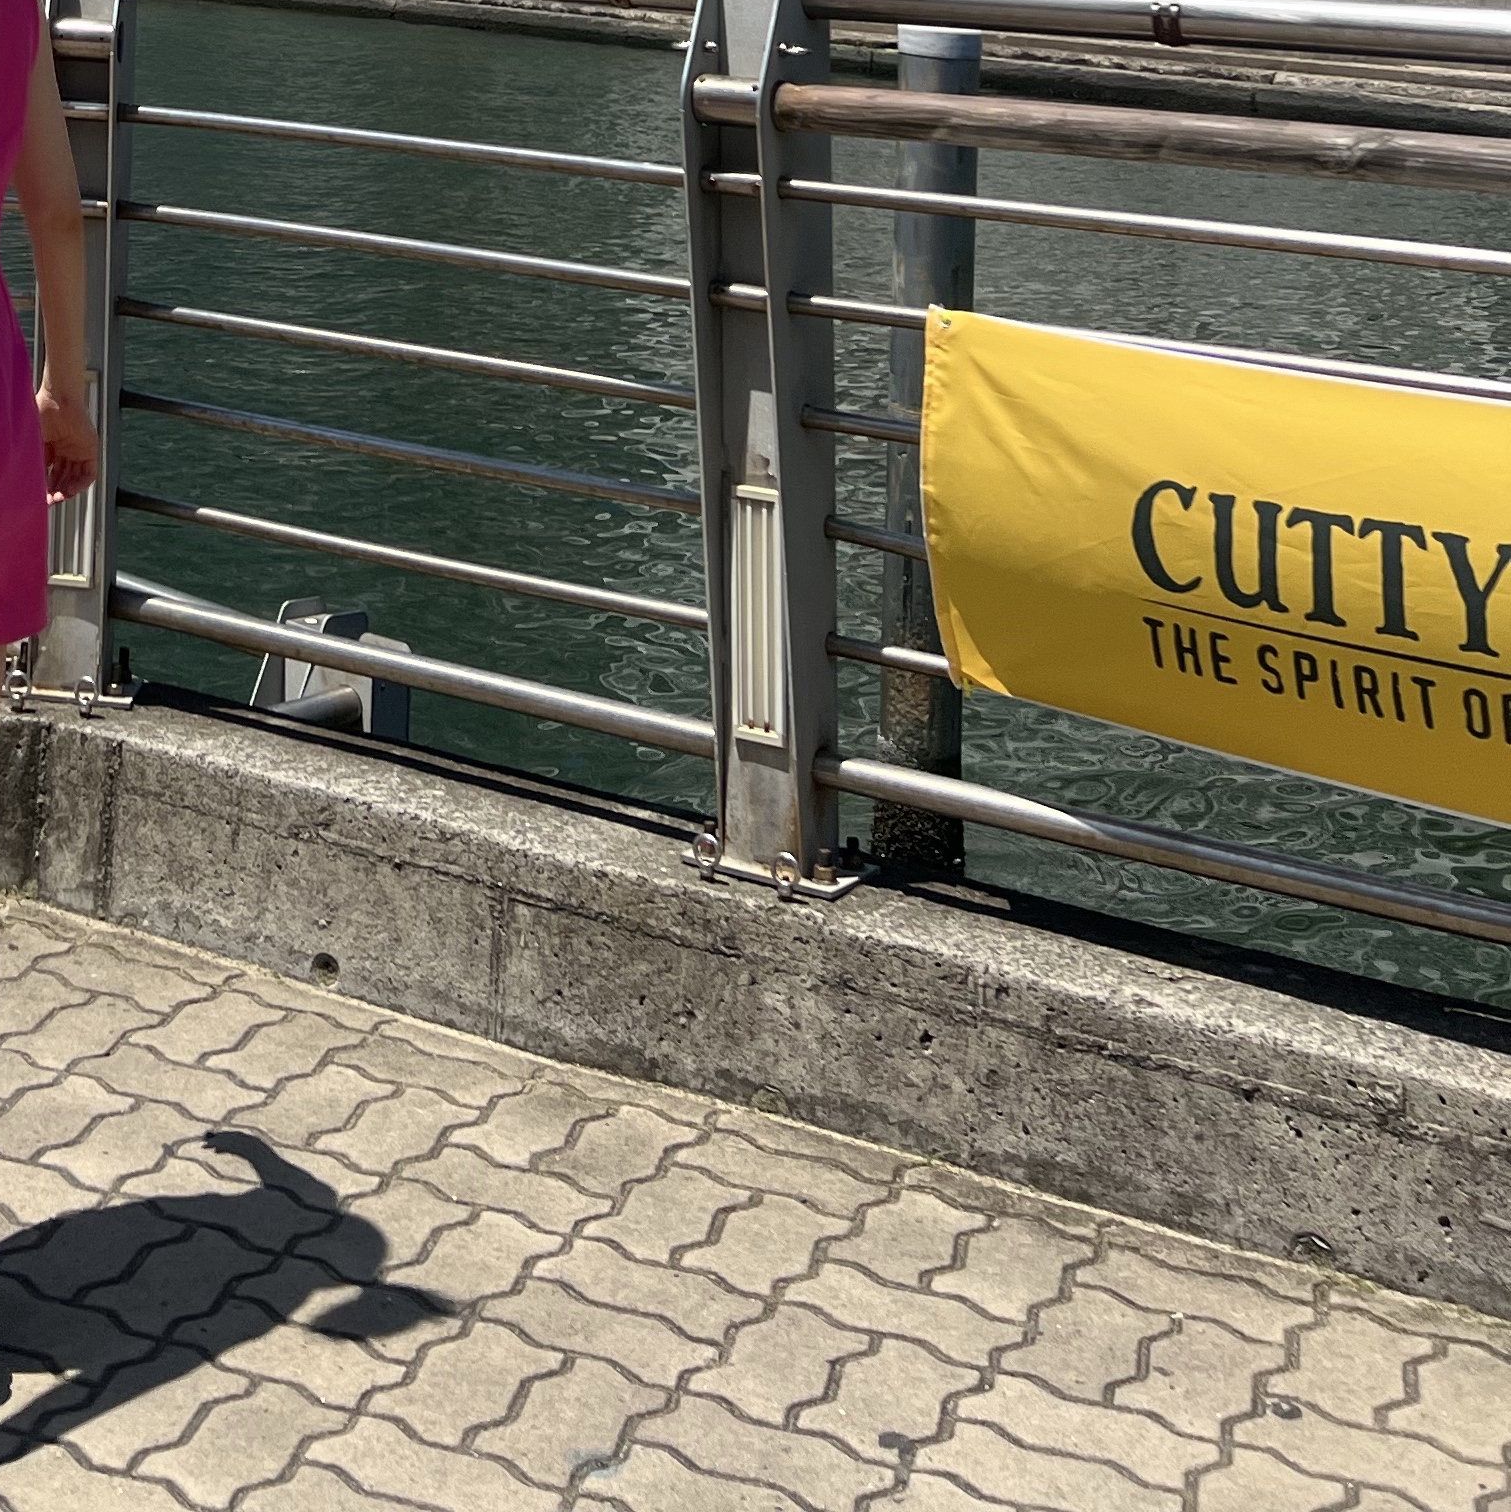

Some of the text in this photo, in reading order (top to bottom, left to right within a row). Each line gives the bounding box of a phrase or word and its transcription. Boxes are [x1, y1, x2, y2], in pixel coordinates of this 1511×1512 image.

[1132, 480, 1511, 658] CUTTY
[1143, 616, 1238, 685] THE
[1257, 644, 1436, 730] SPIRIT
